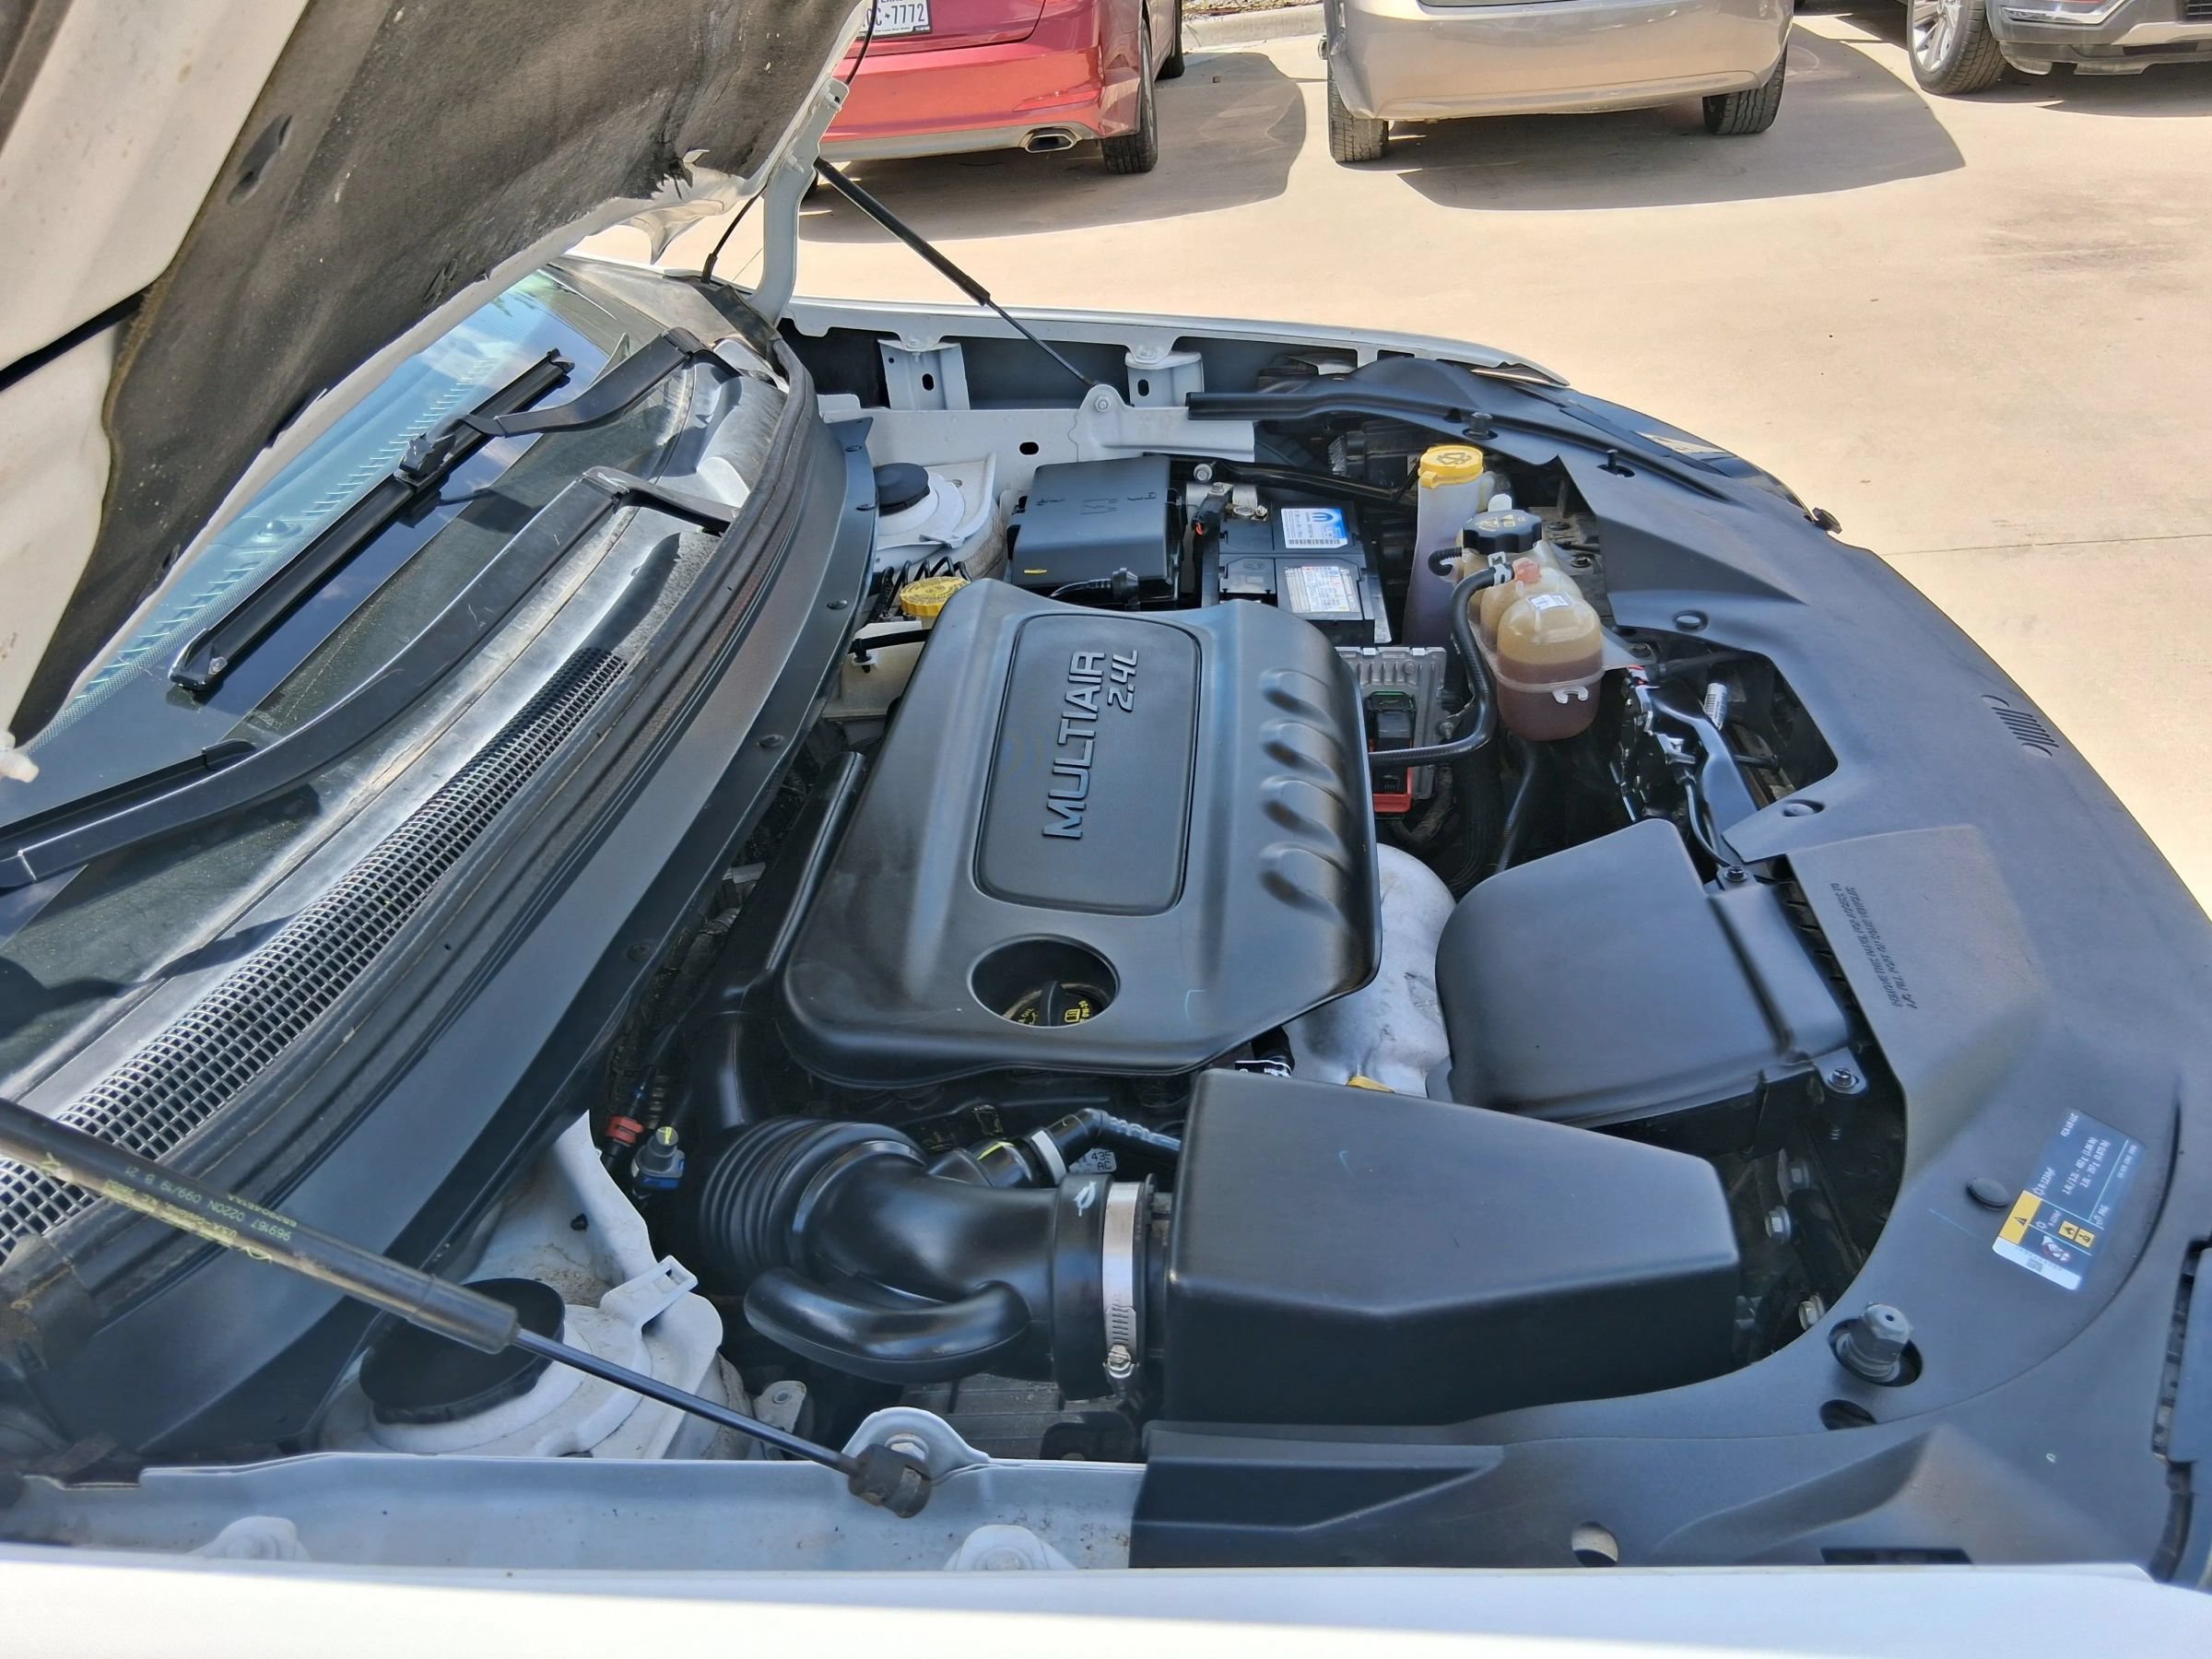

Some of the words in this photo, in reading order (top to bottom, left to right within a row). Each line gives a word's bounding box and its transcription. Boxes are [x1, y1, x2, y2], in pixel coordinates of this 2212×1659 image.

[891, 4, 924, 25] 7772
[1107, 650, 1138, 712] 2.4L
[1042, 651, 1106, 841] MULTIAIR
[1098, 1161, 1112, 1171] AC
[209, 1200, 245, 1222] 0220N
[251, 1219, 291, 1241] 969167
